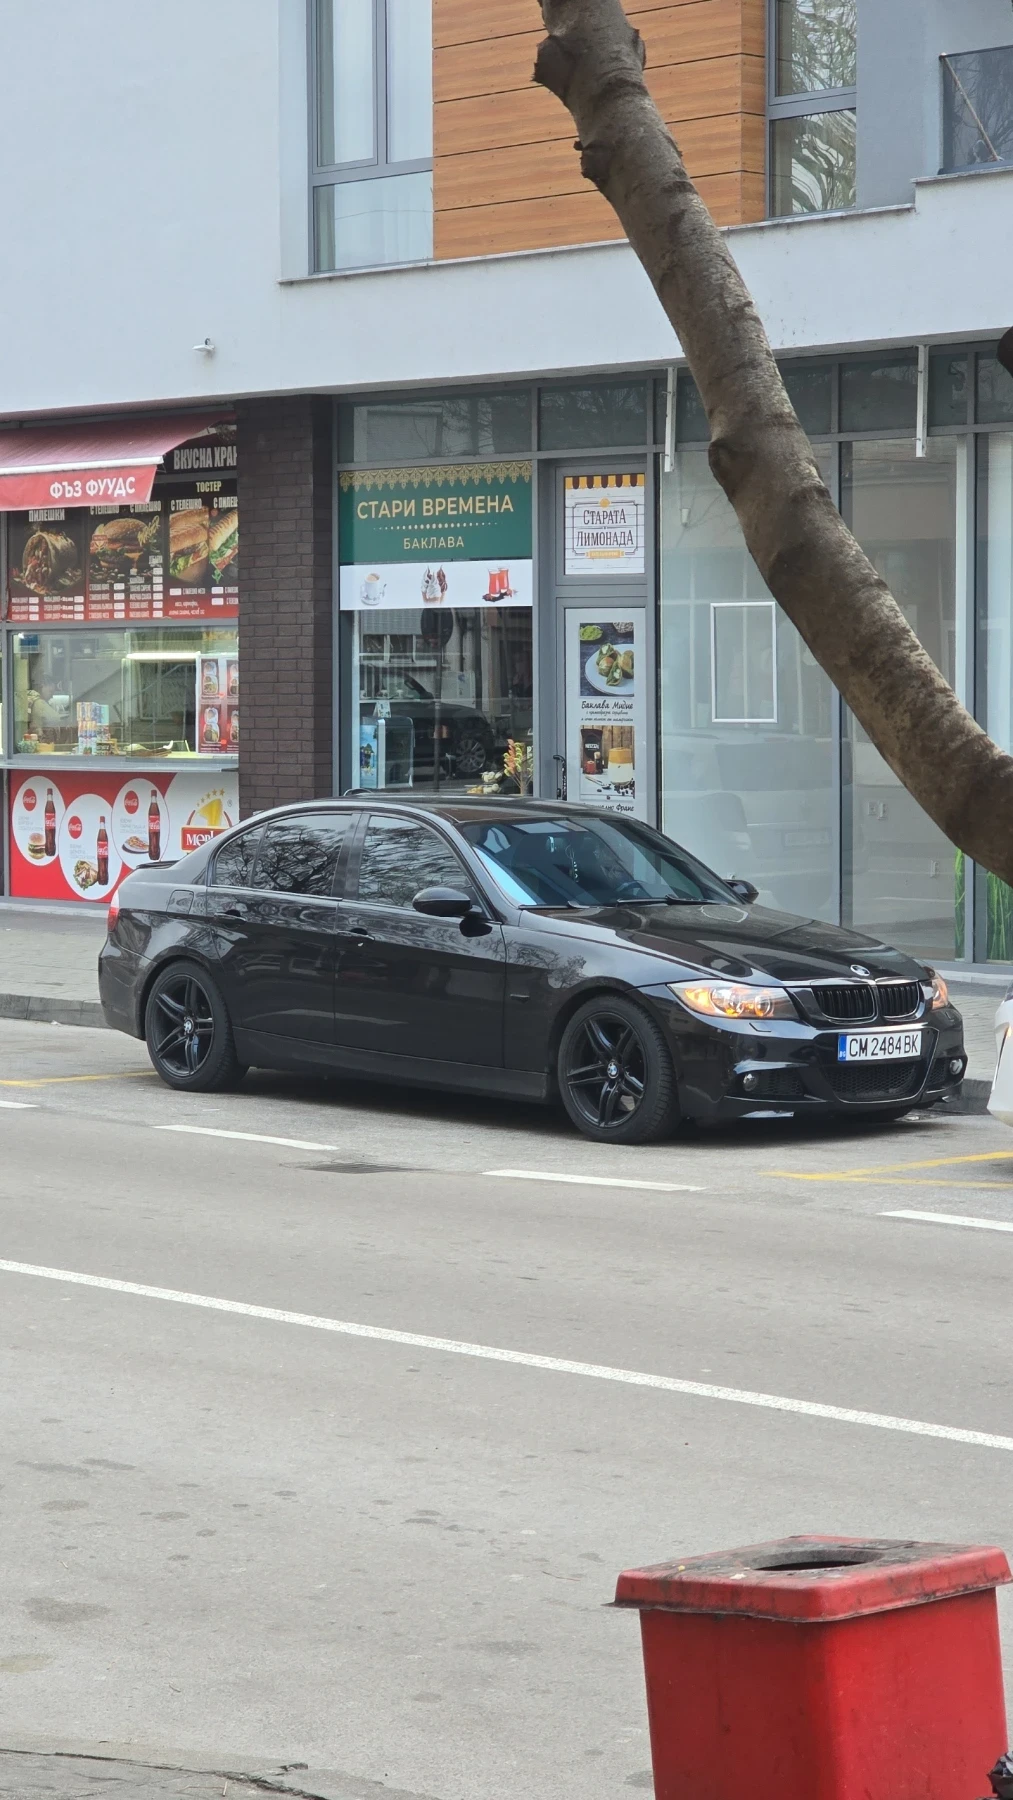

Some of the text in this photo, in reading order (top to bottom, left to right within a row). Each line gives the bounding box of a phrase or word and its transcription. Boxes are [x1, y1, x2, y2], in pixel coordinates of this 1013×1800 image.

[173, 447, 213, 470] ВКУСНА
[49, 476, 135, 499] ФЪЗ ФУУДС
[196, 480, 222, 493] ТОСТЕР
[28, 508, 65, 522] ПИЛЕШКИ
[356, 494, 514, 520] СТАРИ ВРЕМЕНА
[583, 508, 627, 525] СТАРАТА
[403, 535, 465, 550] БАКЛАВА
[576, 529, 634, 547] ЛИМОНАДА
[581, 699, 610, 710] Баклава
[849, 1034, 919, 1058] CM 2484 BK
